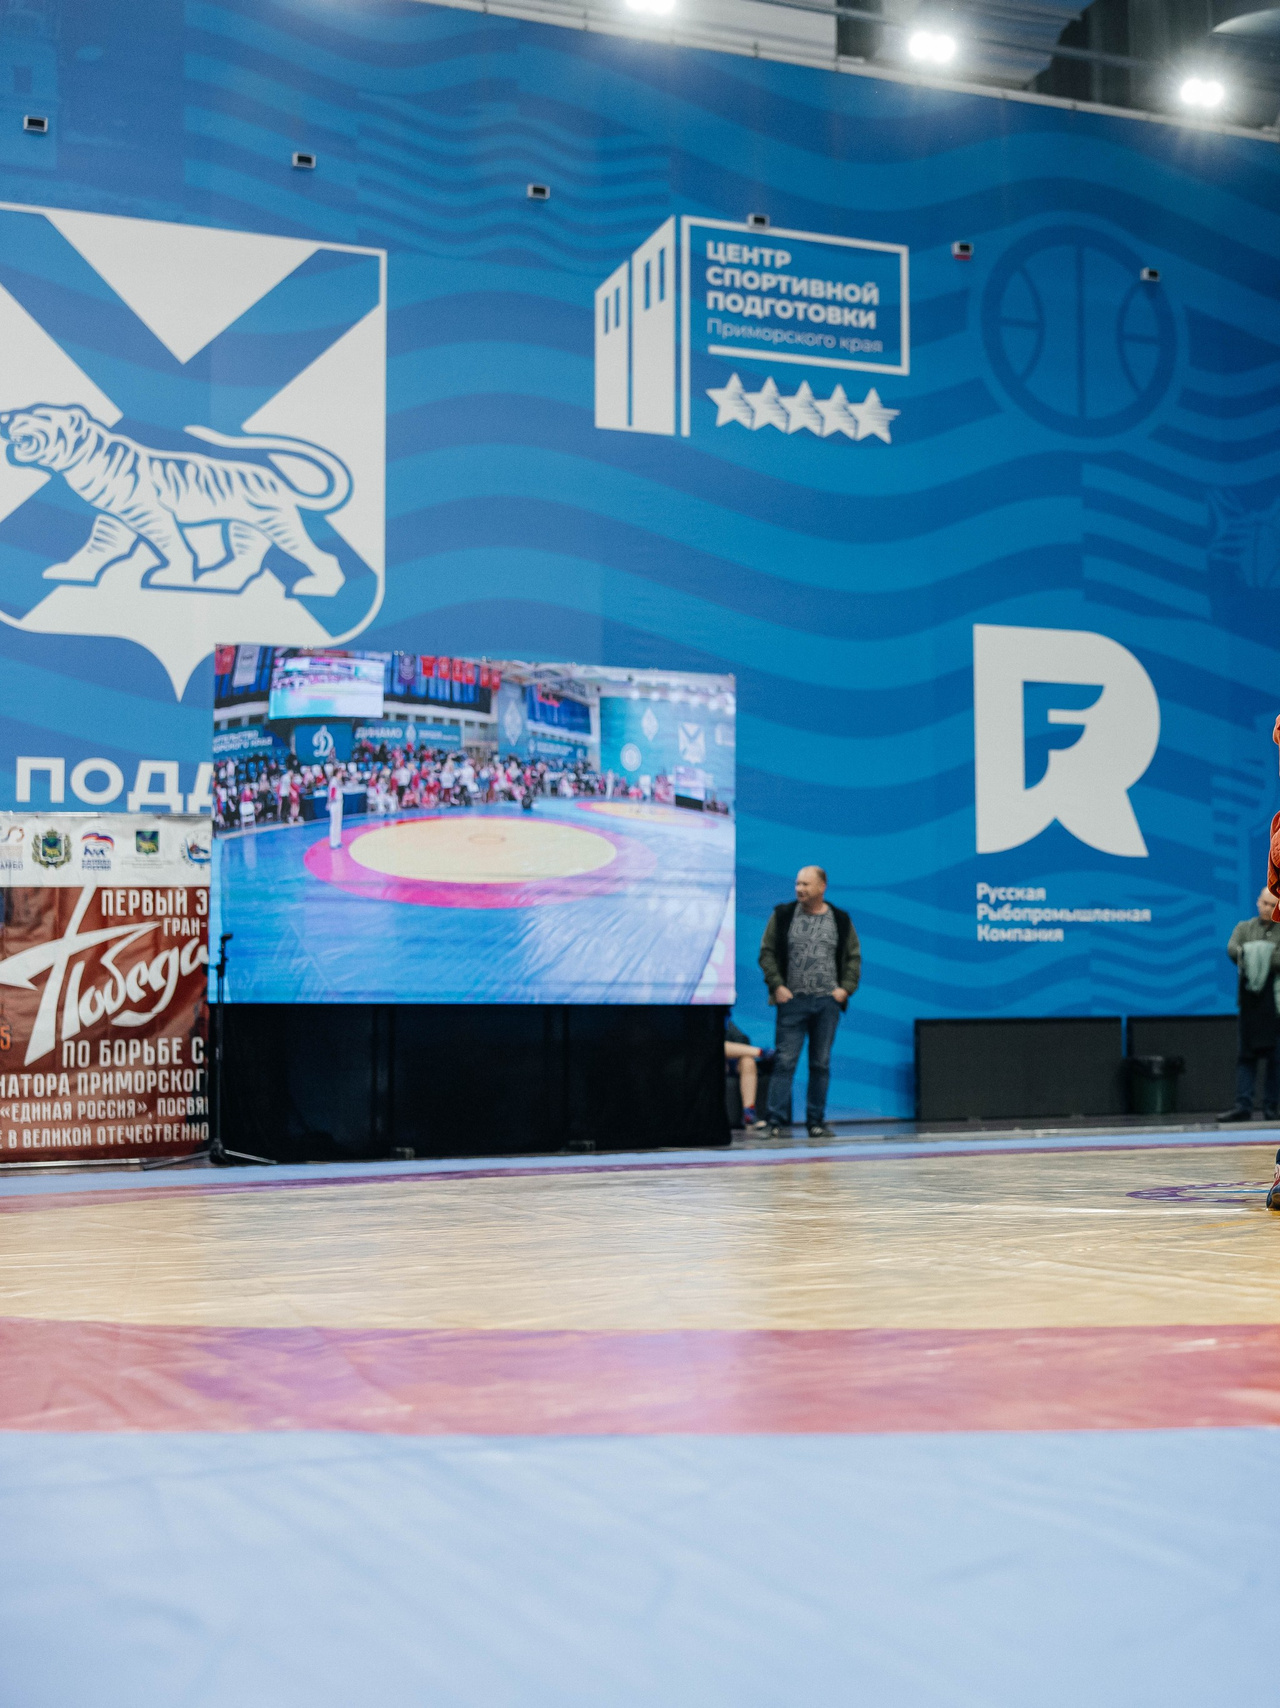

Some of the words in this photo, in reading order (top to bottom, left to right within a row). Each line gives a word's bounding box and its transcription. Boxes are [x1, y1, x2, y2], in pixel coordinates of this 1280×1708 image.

[706, 240, 792, 268] ЦЕНТР
[706, 266, 880, 305] СПОРТИВНОЙ
[706, 291, 877, 330] ПОДГОТОВКИ
[707, 318, 836, 349] Приморского
[840, 335, 883, 354] края
[101, 886, 188, 917] ПЕРВЫЙ
[196, 889, 210, 916] Э
[976, 882, 1047, 904] Русская
[976, 903, 1152, 925] Рыбопромышленная
[977, 924, 1064, 942] Компания
[62, 1039, 90, 1068] ПО
[99, 1037, 183, 1068] БОРЬБЕ
[77, 1068, 209, 1097] ПРИМОРСКОГ
[8, 1129, 18, 1149] В
[23, 1124, 92, 1148] ВЕЛИКОЙ
[97, 1122, 209, 1146] ОТЕЧЕСТВЕННО
